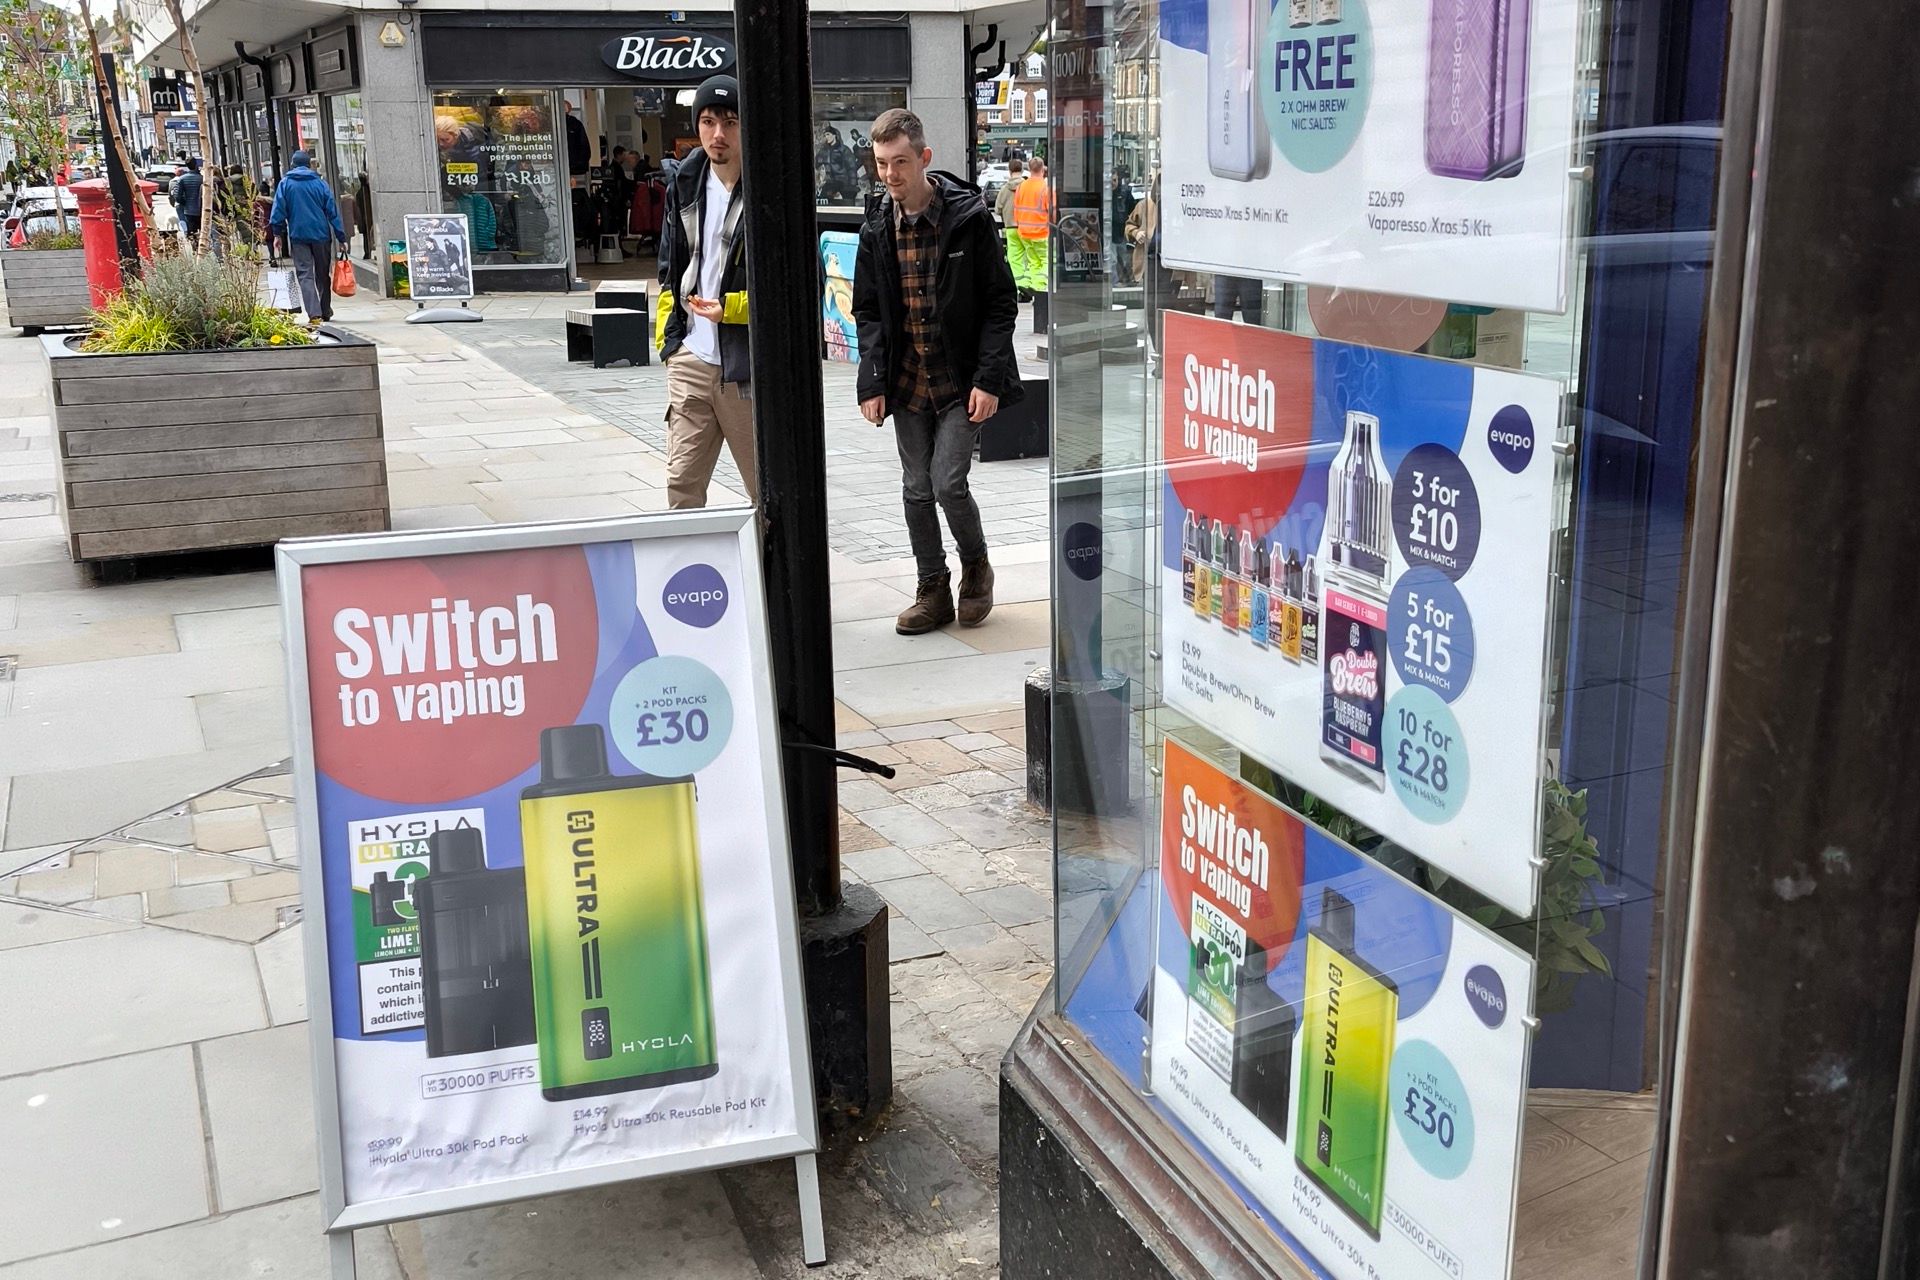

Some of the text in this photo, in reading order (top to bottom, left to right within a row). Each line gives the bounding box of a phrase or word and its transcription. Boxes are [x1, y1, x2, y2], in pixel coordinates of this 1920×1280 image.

[616, 36, 726, 69] Blacks
[1275, 34, 1356, 92] FREE
[1280, 101, 1286, 113] 2
[1296, 100, 1317, 113] OHM
[1319, 99, 1347, 112] BREW
[1291, 117, 1334, 130] NIC SALTS
[480, 143, 552, 153] every mountain
[504, 134, 552, 143] The jacket
[490, 154, 522, 162] person
[447, 174, 478, 185] £149
[520, 170, 551, 184] Rab
[1181, 183, 1205, 198] £19.99
[1181, 203, 1222, 220] Vaporesso
[1245, 206, 1251, 220] 5
[1253, 208, 1273, 223] Mini
[1275, 209, 1289, 223] Kit
[1368, 191, 1405, 208] £26.99
[1367, 214, 1427, 236] Vaporesso
[1461, 217, 1469, 236] 5
[1184, 353, 1276, 434] Switch
[1184, 413, 1258, 472] to vaping
[1490, 429, 1531, 451] evapo
[1412, 471, 1460, 508] 3 for
[1409, 503, 1459, 552] £10
[1409, 545, 1423, 557] MIX
[1431, 552, 1456, 569] MATCH
[667, 589, 723, 607] evapo
[1407, 592, 1454, 631] 5 for
[333, 594, 558, 678] Switch
[1404, 623, 1451, 673] £15
[1346, 650, 1378, 669] Double
[1182, 657, 1276, 719] Double Brew/Ohm Brew
[1182, 674, 1214, 704] Nic Salts
[1330, 655, 1378, 701] Brew
[1404, 663, 1418, 676] MIX
[1425, 672, 1450, 690] MATCH
[339, 671, 526, 727] to vaping
[643, 695, 707, 709] 2 POD PACKS
[662, 687, 677, 695] KIT
[1333, 696, 1367, 724] BLUEBERRY
[1335, 709, 1369, 737] RASPBERRY
[636, 709, 709, 747] £30
[1399, 708, 1452, 752] 10 for
[1397, 738, 1448, 792] £28
[363, 840, 431, 860] ULTRA
[1181, 784, 1269, 893] Switch
[572, 838, 600, 938] ULTRA
[1181, 837, 1196, 875] to
[1199, 854, 1252, 919] vaping
[374, 950, 393, 958] LEMON
[381, 934, 413, 949] LIME
[1224, 935, 1242, 959] POD
[389, 967, 416, 978] This
[377, 981, 422, 995] contain
[1466, 978, 1504, 1012] evapo
[379, 995, 415, 1009] which
[371, 1010, 425, 1025] addictive
[1325, 987, 1340, 1066] ULTRA
[622, 1034, 693, 1053] HYOLA
[438, 1073, 485, 1092] 30000
[490, 1065, 535, 1084] PUFFS
[1427, 1071, 1439, 1086] KIT
[1418, 1078, 1434, 1096] POD
[1435, 1092, 1458, 1115] PACKS
[573, 1106, 608, 1121] £14.99
[611, 1117, 641, 1129] Ultra
[670, 1104, 721, 1120] Reusable
[725, 1099, 747, 1111] Pod
[750, 1097, 766, 1108] Kit
[1404, 1087, 1455, 1149] £30
[410, 1147, 443, 1160] Ultra
[446, 1141, 469, 1154] 30k
[473, 1137, 496, 1150] Pod
[500, 1133, 529, 1146] Pack
[1226, 1127, 1242, 1151] Pod
[1243, 1144, 1264, 1170] Pack
[1294, 1175, 1321, 1207] £14.99
[1292, 1193, 1318, 1226] Hyola
[1320, 1217, 1345, 1251] Ultra
[1346, 1244, 1365, 1269] 30k
[1393, 1210, 1459, 1277] 30000 PUFFS
